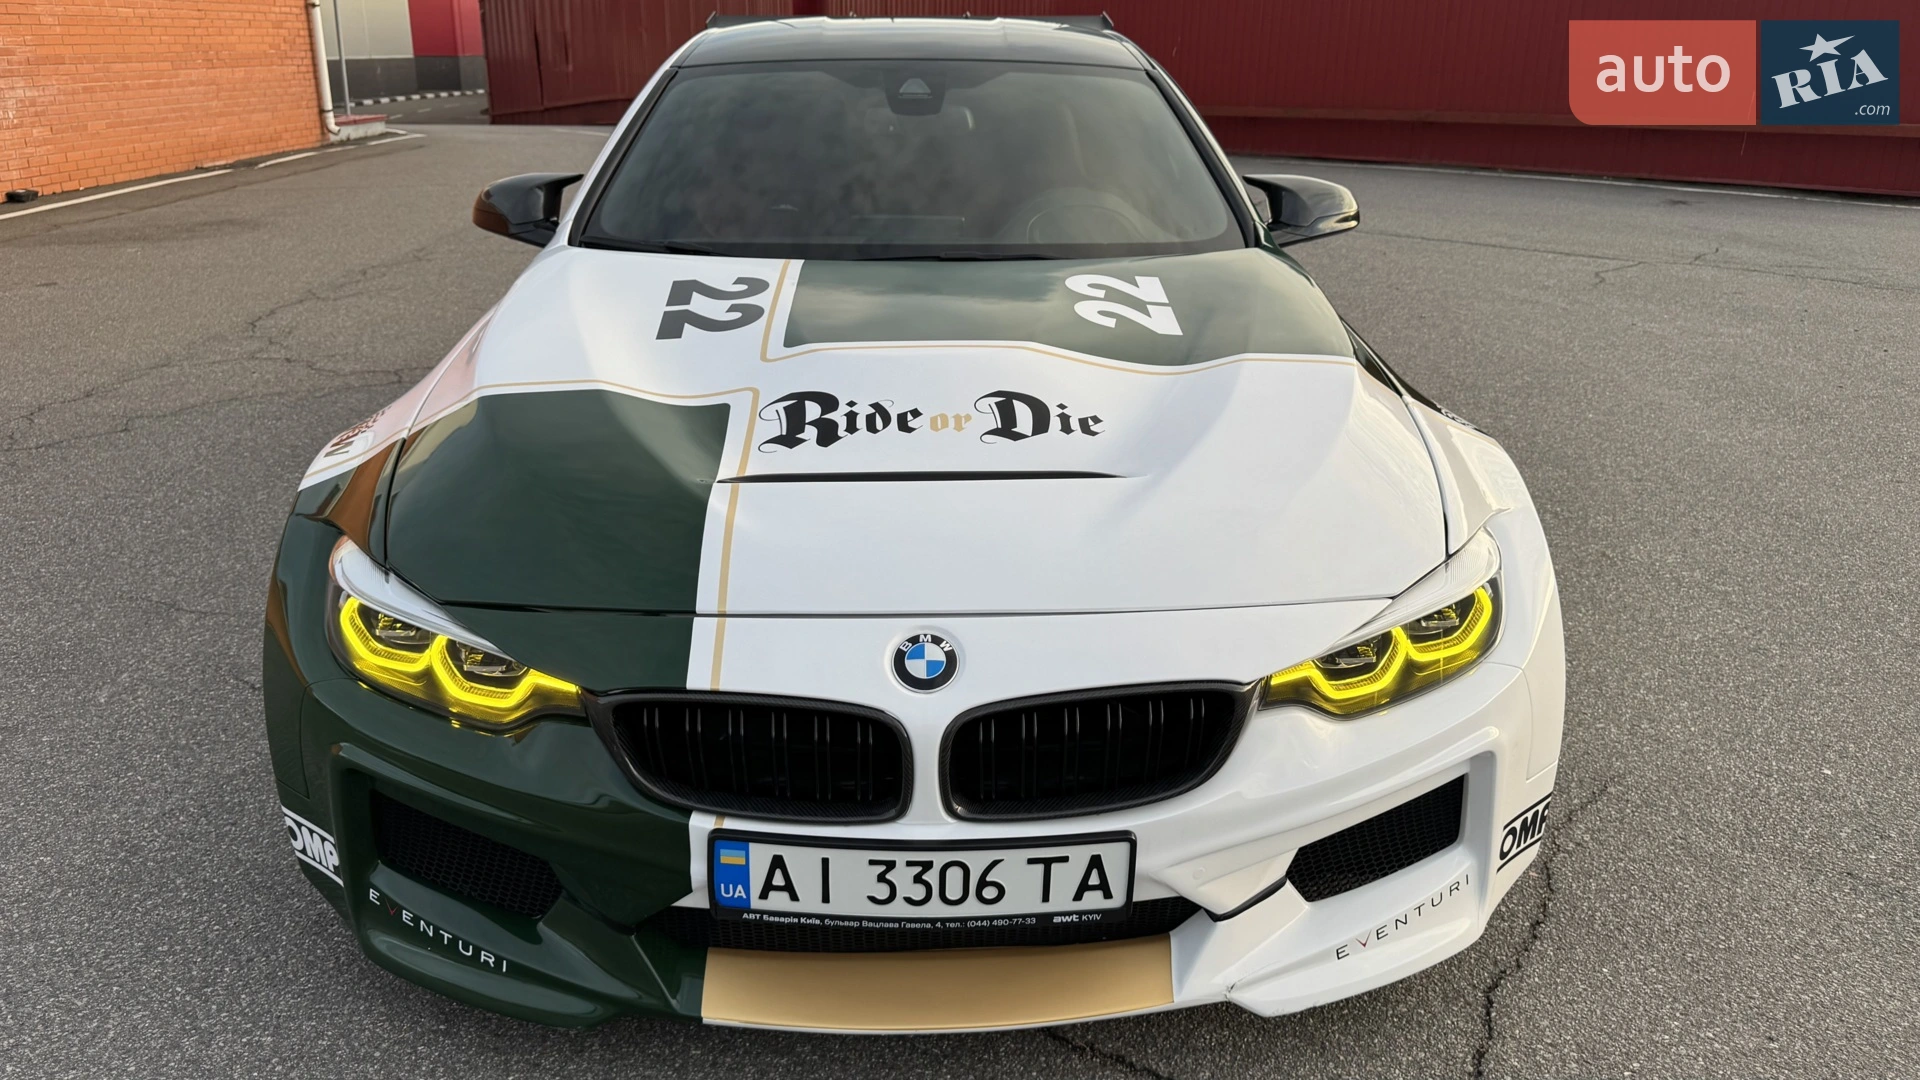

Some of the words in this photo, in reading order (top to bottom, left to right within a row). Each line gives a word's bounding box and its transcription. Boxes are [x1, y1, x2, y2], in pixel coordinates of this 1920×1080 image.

[655, 276, 770, 340] 22
[1064, 274, 1184, 336] 22
[758, 390, 923, 453] Ride
[929, 412, 973, 433] or
[974, 390, 1105, 444] Die
[899, 634, 953, 652] BMW
[284, 815, 340, 873] OMP
[720, 882, 747, 900] UA
[866, 858, 1007, 907] 3306
[1026, 854, 1115, 904] TA
[369, 888, 507, 973] EVENTURI
[763, 914, 799, 923] Баварія
[824, 919, 860, 928] бульвар
[862, 920, 899, 928] Вацлава
[967, 920, 990, 928] (044)
[992, 917, 1036, 926] 490-77-33
[1052, 914, 1079, 923] awt
[1336, 874, 1470, 960] EVENTURI
